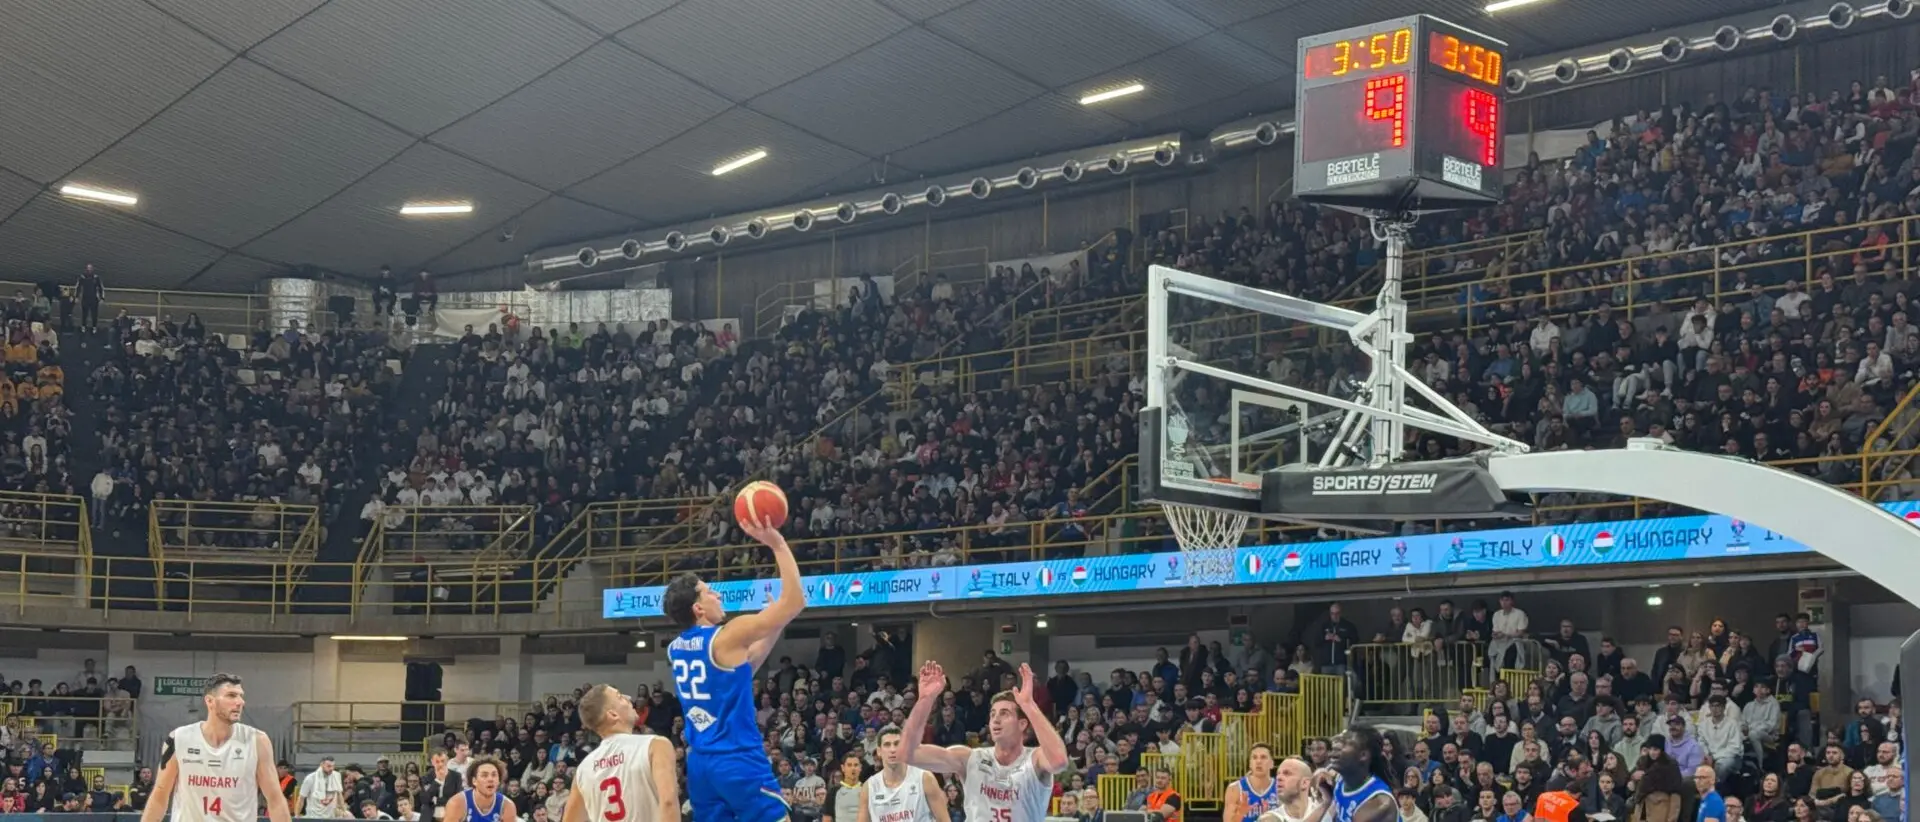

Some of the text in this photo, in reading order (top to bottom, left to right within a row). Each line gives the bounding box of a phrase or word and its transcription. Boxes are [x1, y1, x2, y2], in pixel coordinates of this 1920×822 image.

[1332, 28, 1411, 76] 3:50
[1444, 36, 1502, 85] 3:50
[1365, 75, 1405, 147] 9
[1467, 88, 1498, 166] 9
[1479, 539, 1534, 558] ITALY
[1624, 527, 1713, 550] HUNGARY
[1309, 549, 1382, 569] HUNGARY
[868, 578, 922, 594] HUNGARY
[991, 572, 1032, 588] ITALY
[1094, 563, 1156, 582] HUNGARY
[630, 588, 756, 610] ITALY NGARY
[673, 659, 712, 700] 22
[188, 774, 240, 789] HUNGARY
[203, 796, 222, 816] 14
[600, 776, 626, 822] 3
[990, 806, 1012, 822] 35
